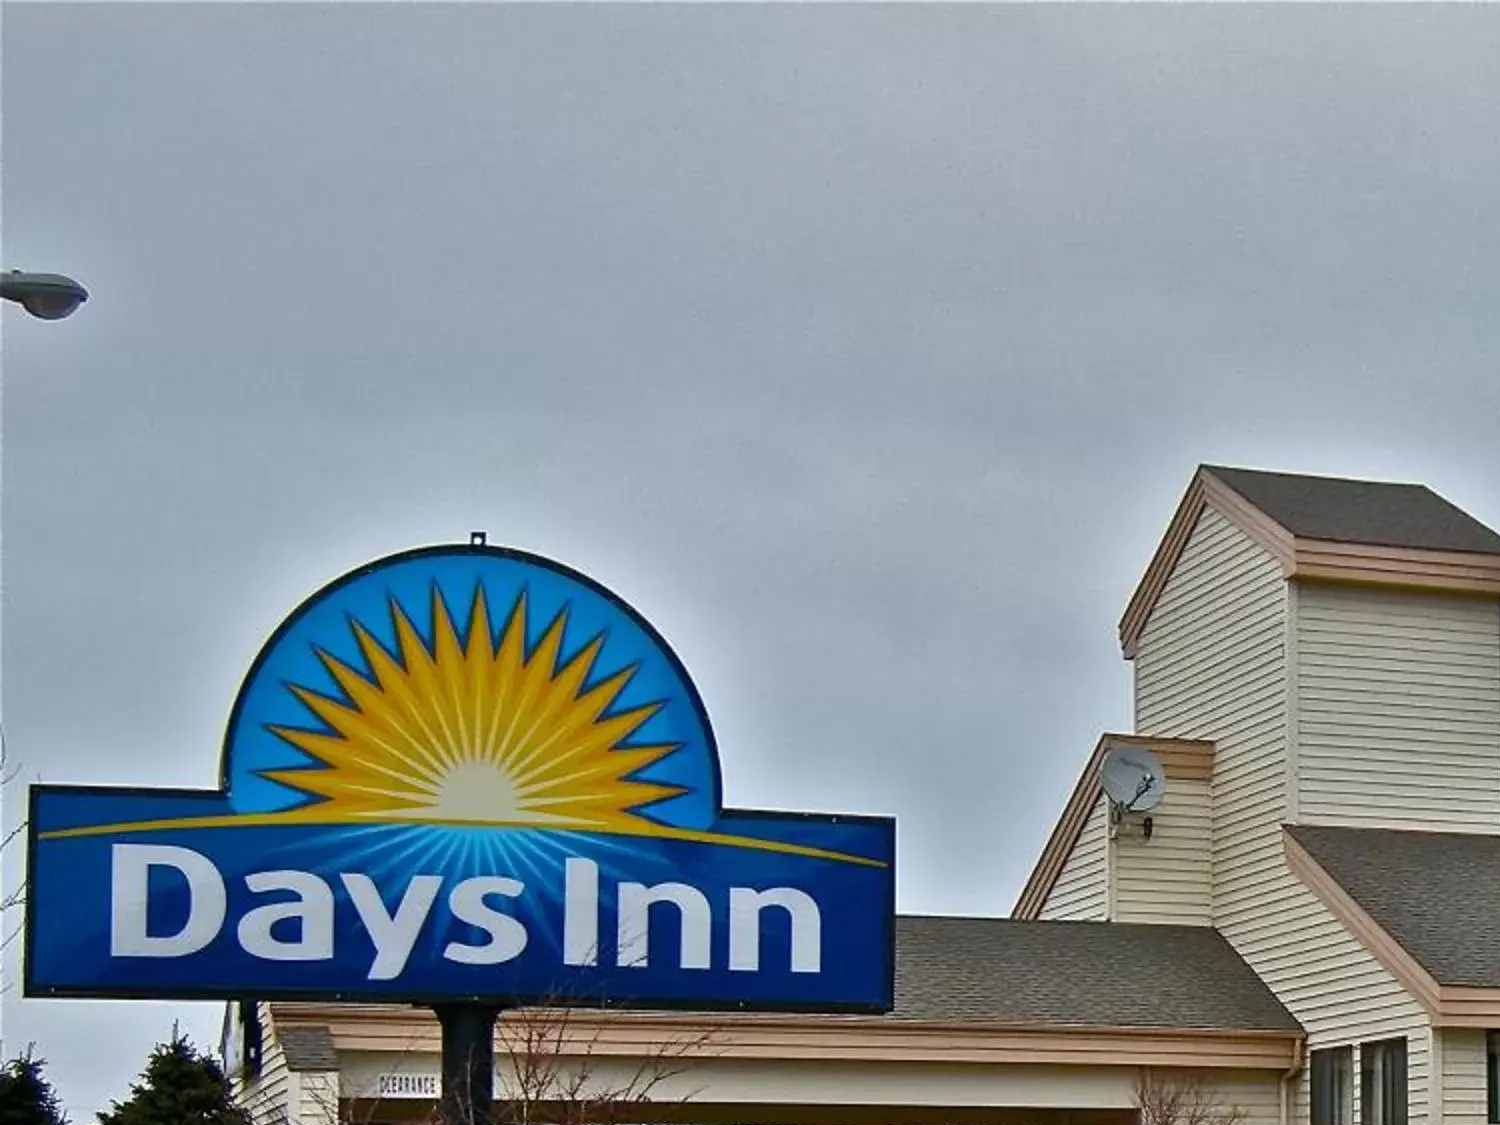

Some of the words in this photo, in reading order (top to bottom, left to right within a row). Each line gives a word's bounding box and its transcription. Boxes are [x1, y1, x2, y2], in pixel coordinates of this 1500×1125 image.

[110, 843, 528, 980] Days
[563, 856, 821, 973] Inn
[380, 1075, 435, 1093] CLEARANCE
